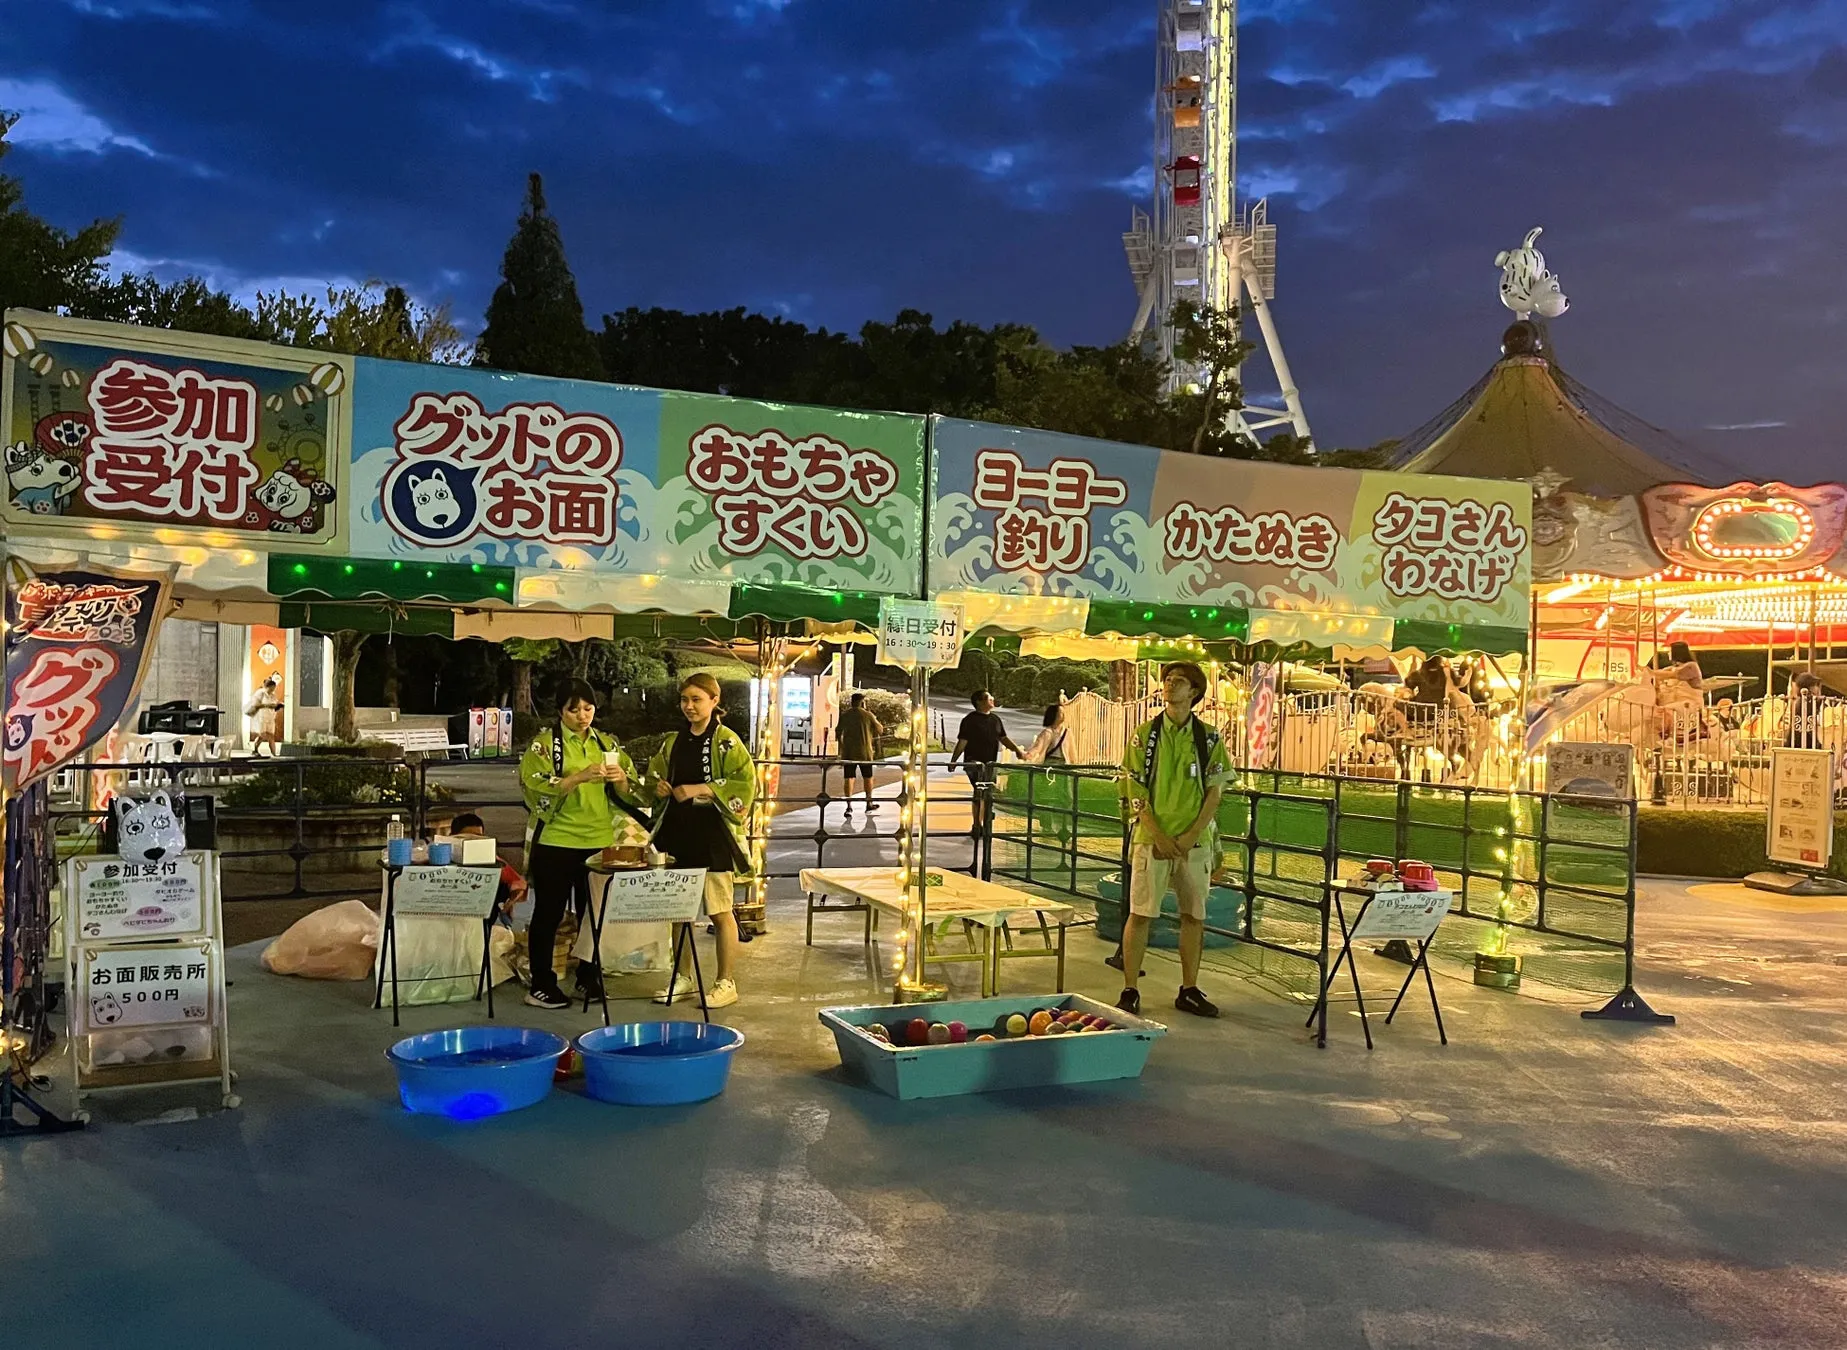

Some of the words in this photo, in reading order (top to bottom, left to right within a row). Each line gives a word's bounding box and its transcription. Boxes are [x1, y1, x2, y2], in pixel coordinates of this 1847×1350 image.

[95, 365, 250, 443] 参加
[400, 401, 612, 475] グッドの
[696, 431, 893, 499] おもちゃ
[91, 443, 247, 515] 受付
[980, 455, 1123, 510] ヨーヨー
[488, 474, 608, 539] お面
[721, 499, 864, 551] すくい
[1374, 498, 1523, 550] タコさん
[1000, 513, 1085, 567] 釣り
[1170, 508, 1334, 566] かたぬき
[1387, 550, 1510, 596] わなげ
[87, 624, 135, 643] 2025
[103, 861, 178, 879] 参加受付
[91, 962, 207, 986] お面販売所
[121, 988, 180, 1004] 500円
